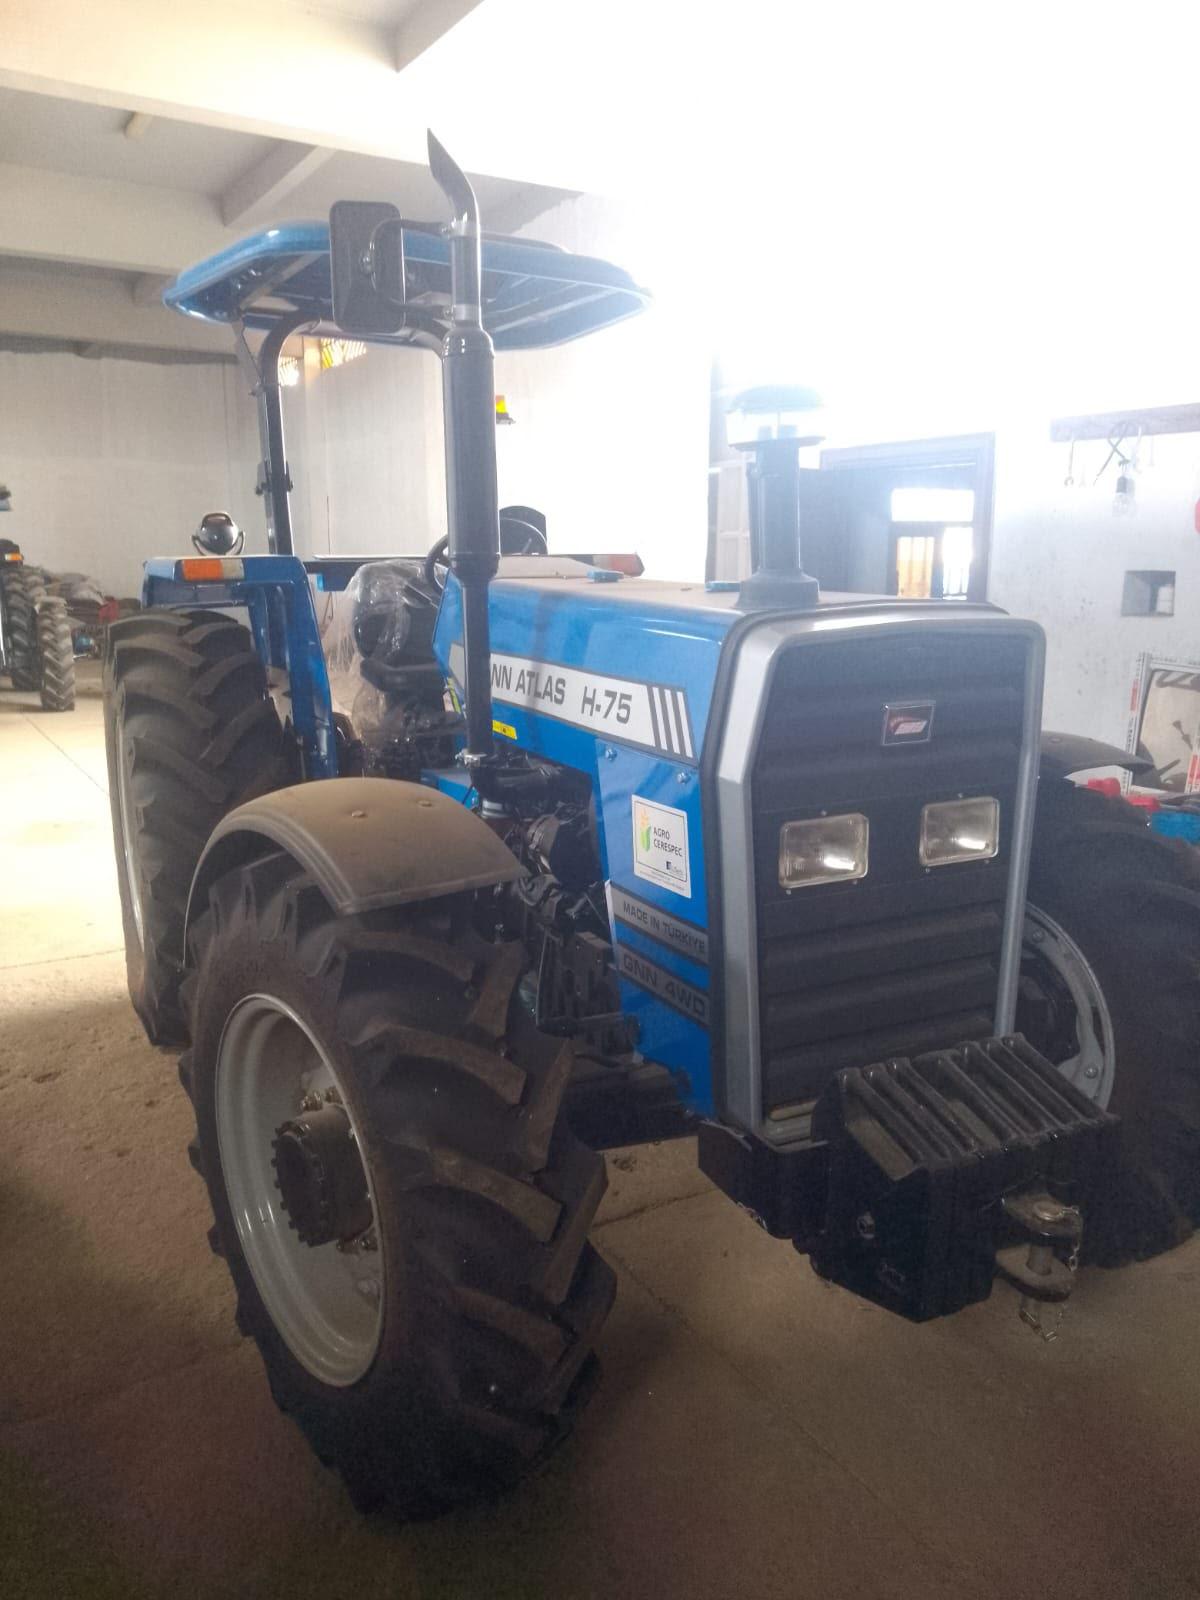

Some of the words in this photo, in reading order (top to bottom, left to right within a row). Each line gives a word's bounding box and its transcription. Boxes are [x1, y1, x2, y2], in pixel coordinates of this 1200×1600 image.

[491, 663, 512, 690] NN
[515, 669, 566, 705] ATLAS
[581, 686, 632, 724] H-75
[653, 827, 670, 841] AGRO
[653, 838, 683, 857] CERESPEC
[623, 902, 648, 925] MADE
[650, 918, 661, 931] IN
[665, 981, 706, 1014] 4WD
